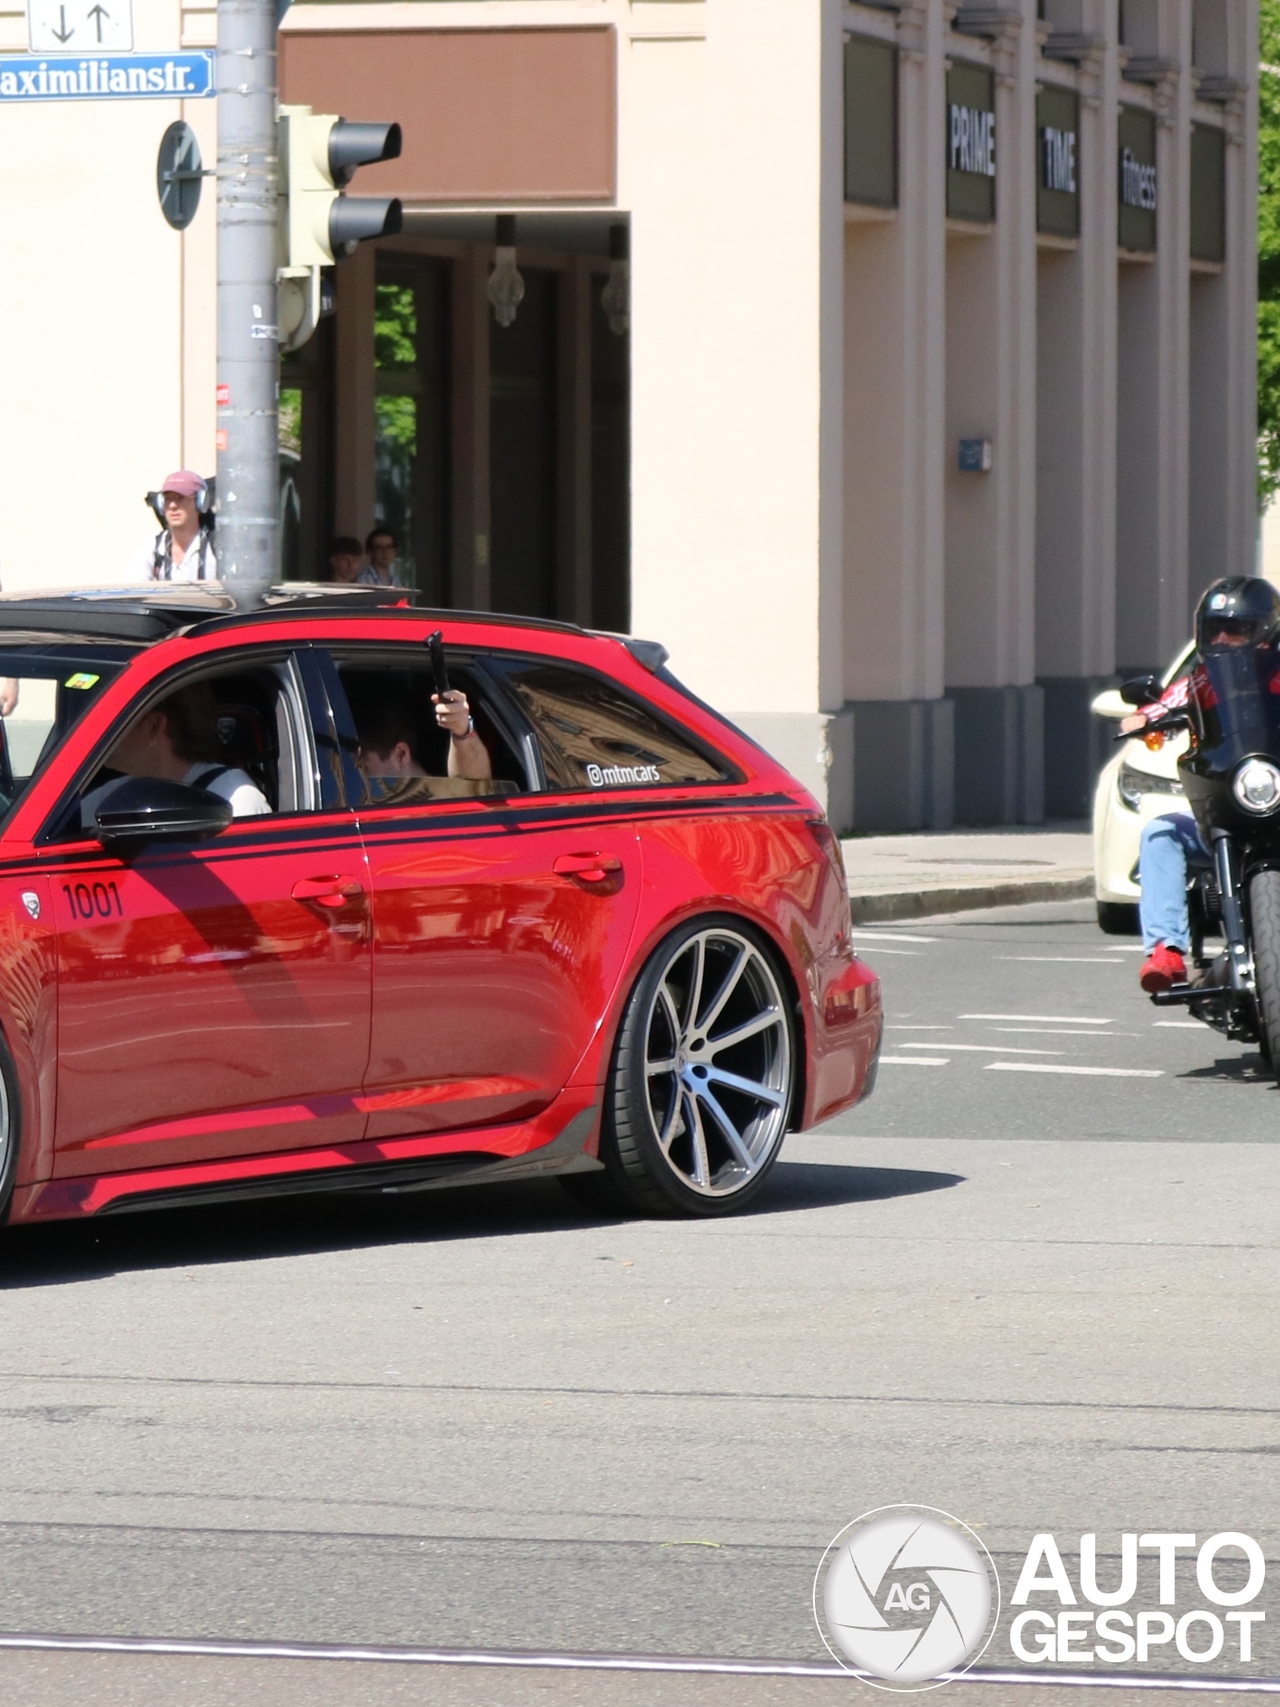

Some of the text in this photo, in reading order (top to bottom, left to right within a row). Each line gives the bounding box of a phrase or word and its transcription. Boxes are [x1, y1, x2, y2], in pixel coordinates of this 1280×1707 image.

[951, 103, 1157, 211] PRIME TIME fitness
[62, 881, 124, 920] 1001
